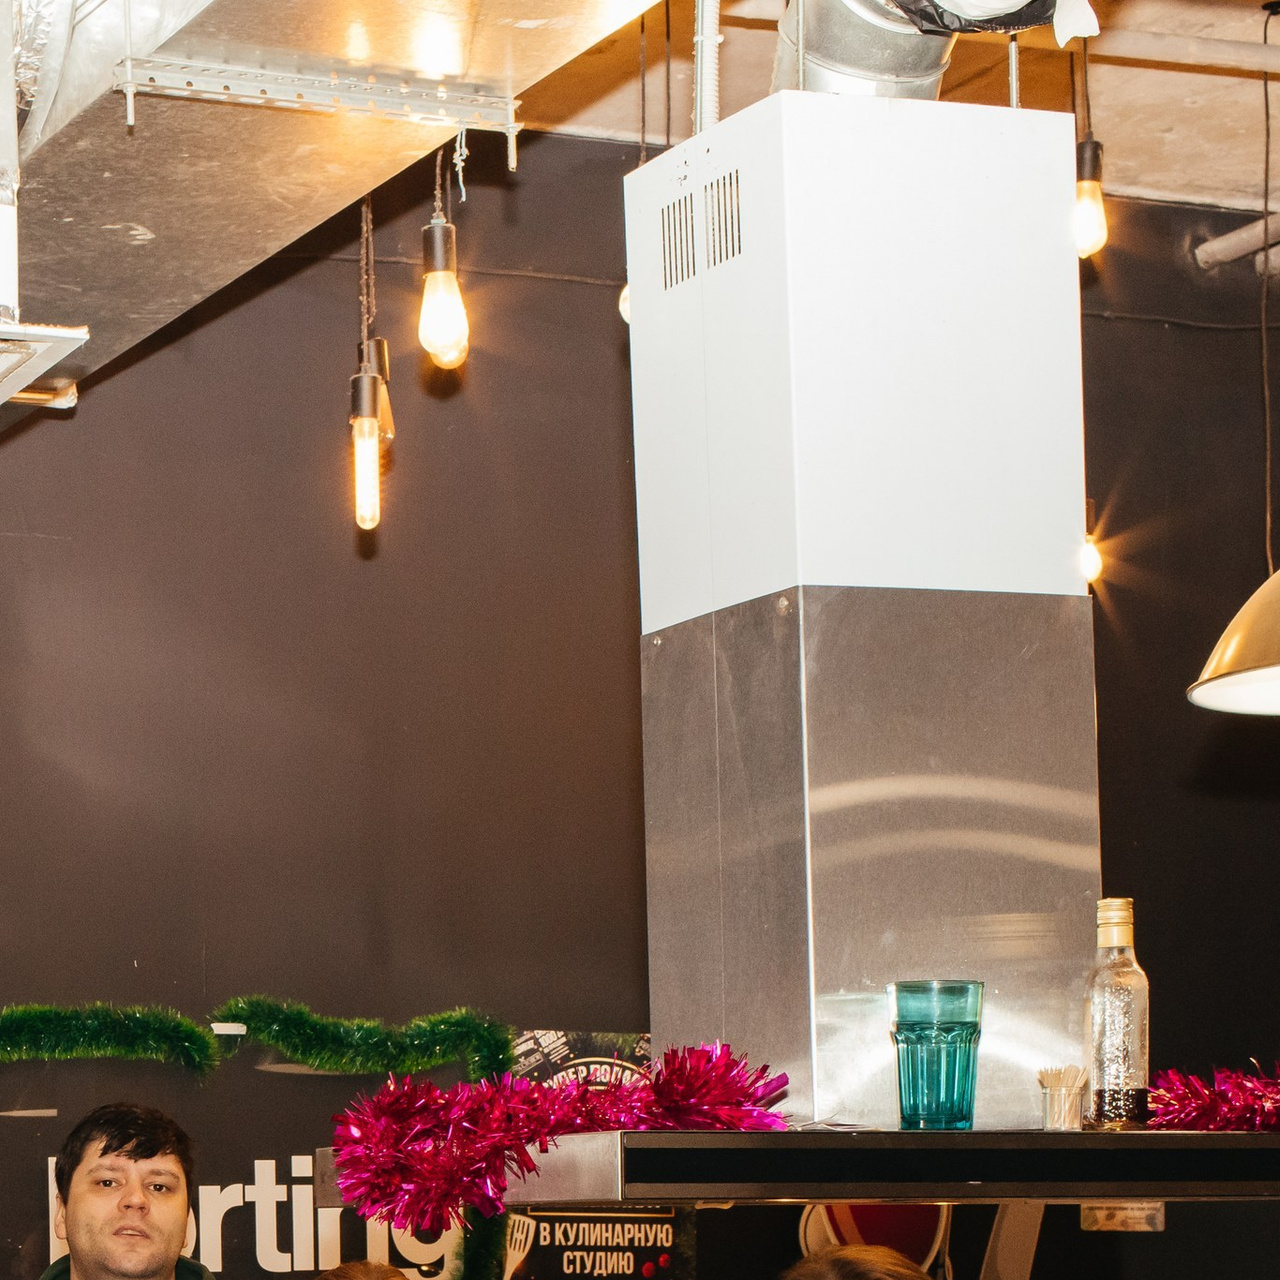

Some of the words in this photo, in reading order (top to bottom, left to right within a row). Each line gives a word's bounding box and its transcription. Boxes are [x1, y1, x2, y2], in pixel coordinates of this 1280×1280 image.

[539, 1222, 551, 1246] В
[554, 1222, 674, 1247] КУЛИНАРНУЮ
[562, 1251, 635, 1277] СТУДИЮ
